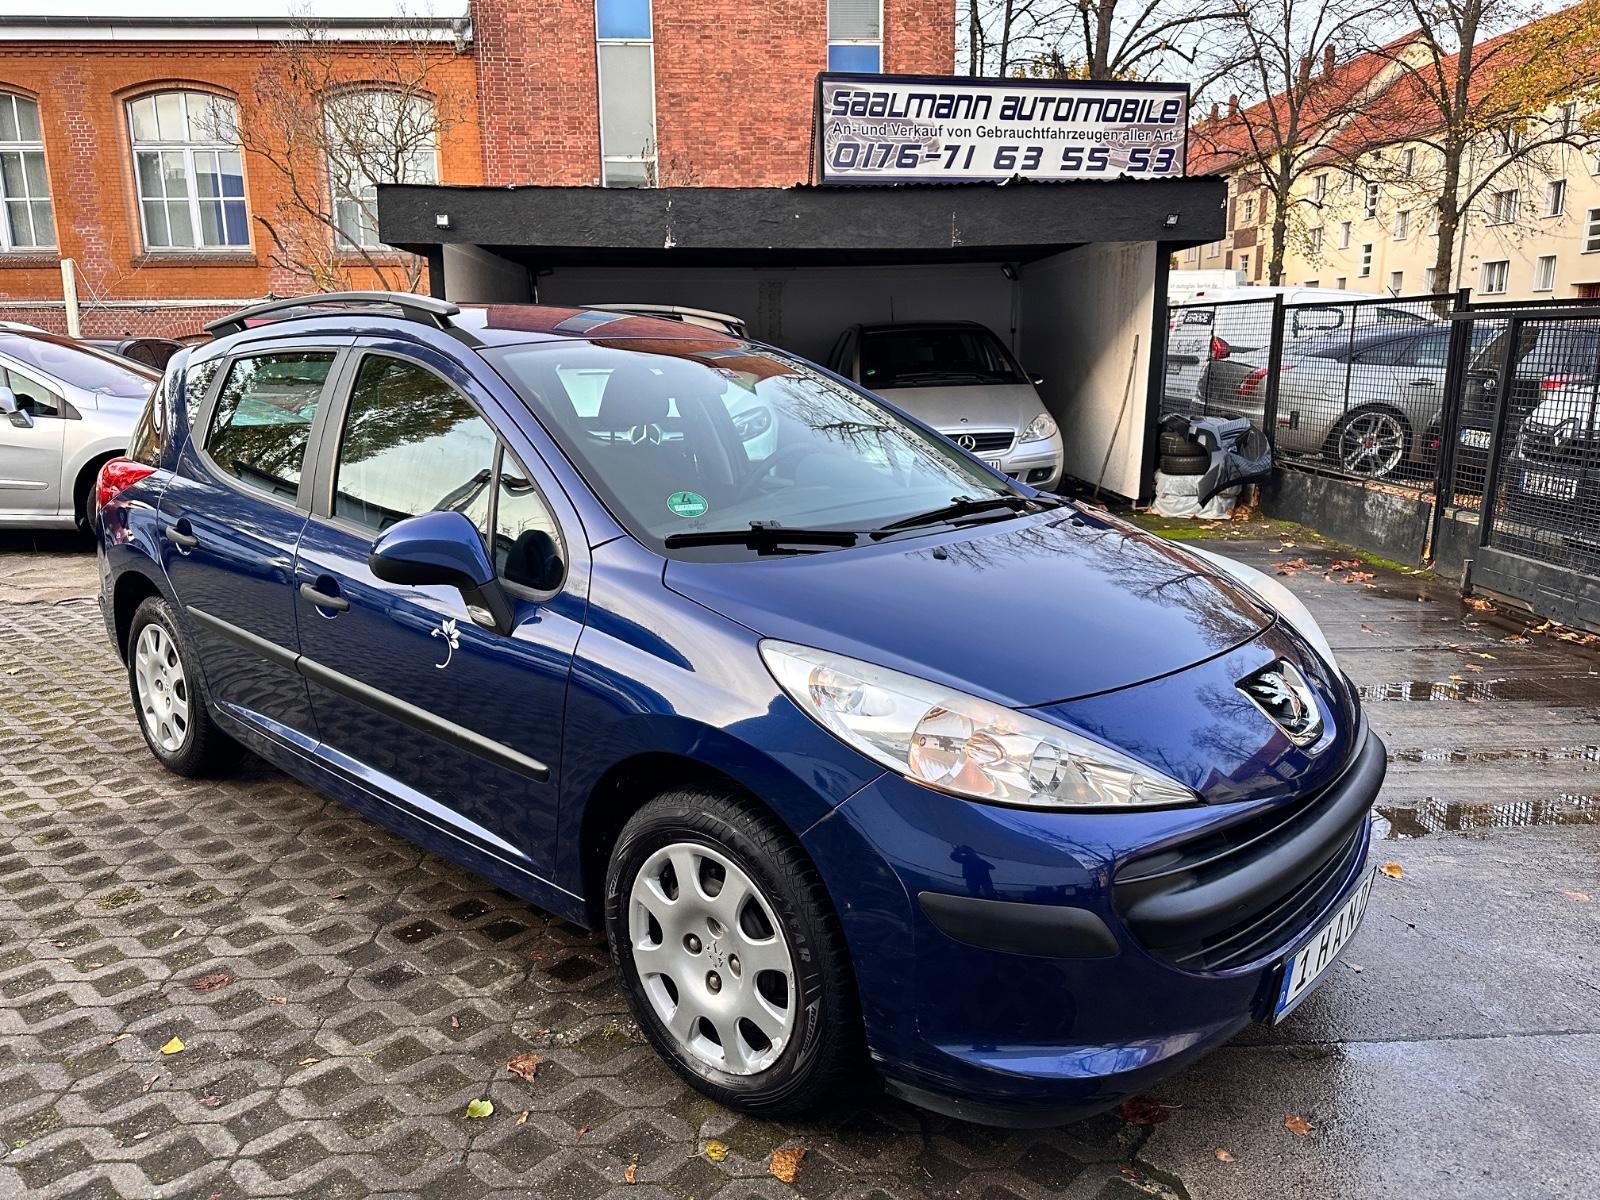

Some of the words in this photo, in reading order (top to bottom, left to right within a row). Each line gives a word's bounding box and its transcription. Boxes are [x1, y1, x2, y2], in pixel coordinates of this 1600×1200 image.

[832, 122, 857, 135] An-
[861, 124, 887, 136] und
[891, 124, 943, 137] Verkauf
[947, 127, 971, 138] von
[976, 125, 1118, 143] Gebrauchtfahrzeugen
[1122, 129, 1150, 141] aller
[1153, 129, 1178, 141] Art.
[832, 142, 976, 170] 0176-71
[993, 145, 1044, 171] 63
[1060, 147, 1111, 172] 55
[1126, 148, 1176, 173] 53
